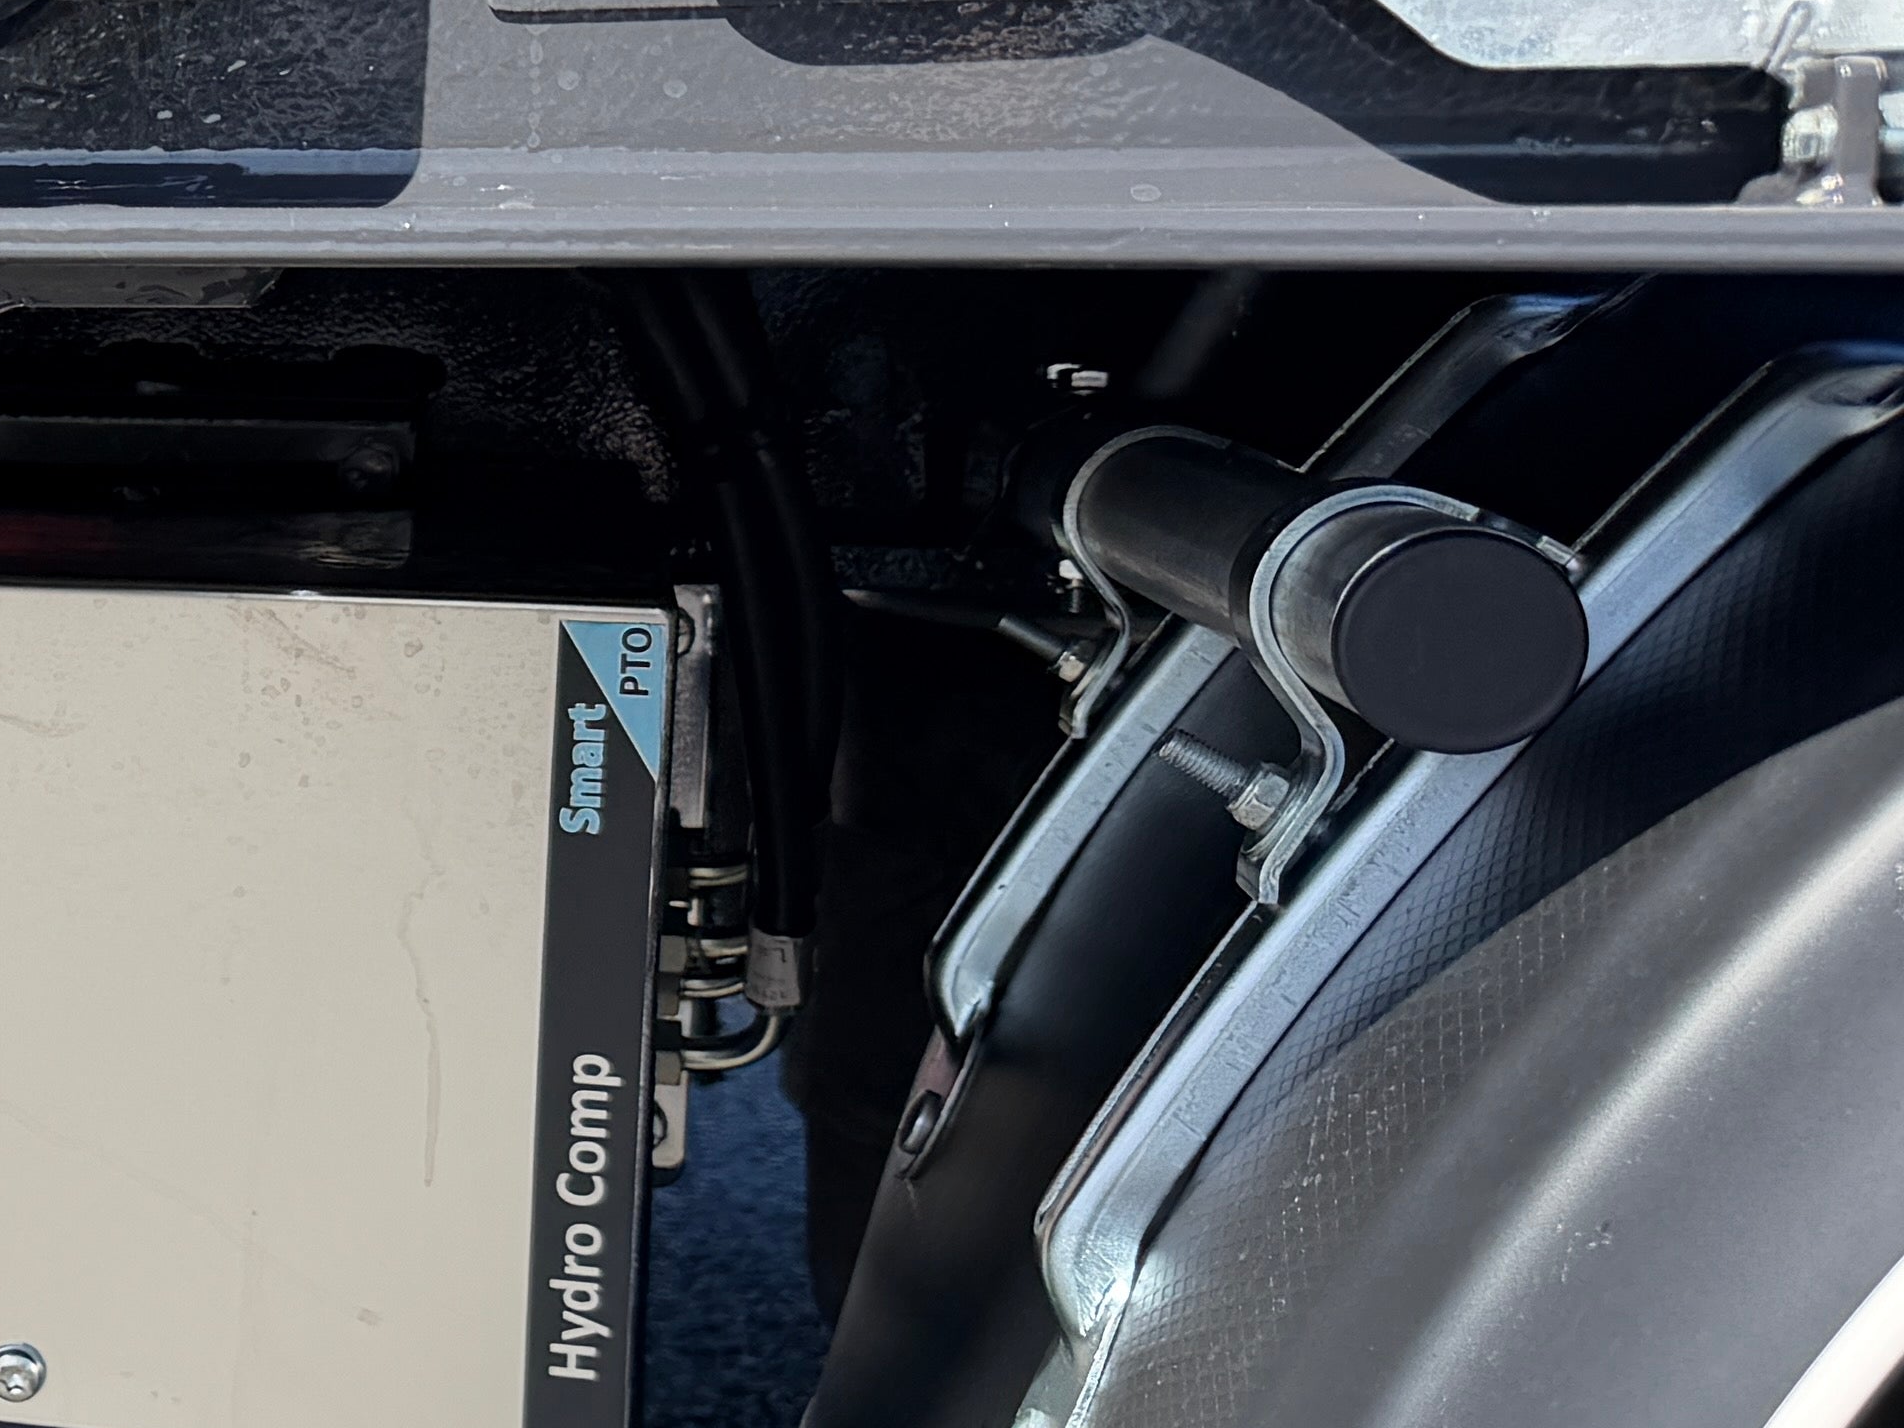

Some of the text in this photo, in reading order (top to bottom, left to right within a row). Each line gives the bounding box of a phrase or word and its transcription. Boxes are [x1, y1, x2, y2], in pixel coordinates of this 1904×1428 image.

[619, 626, 654, 697] PTO
[558, 702, 607, 835] Smart
[548, 1053, 624, 1382] Hydro Comp
